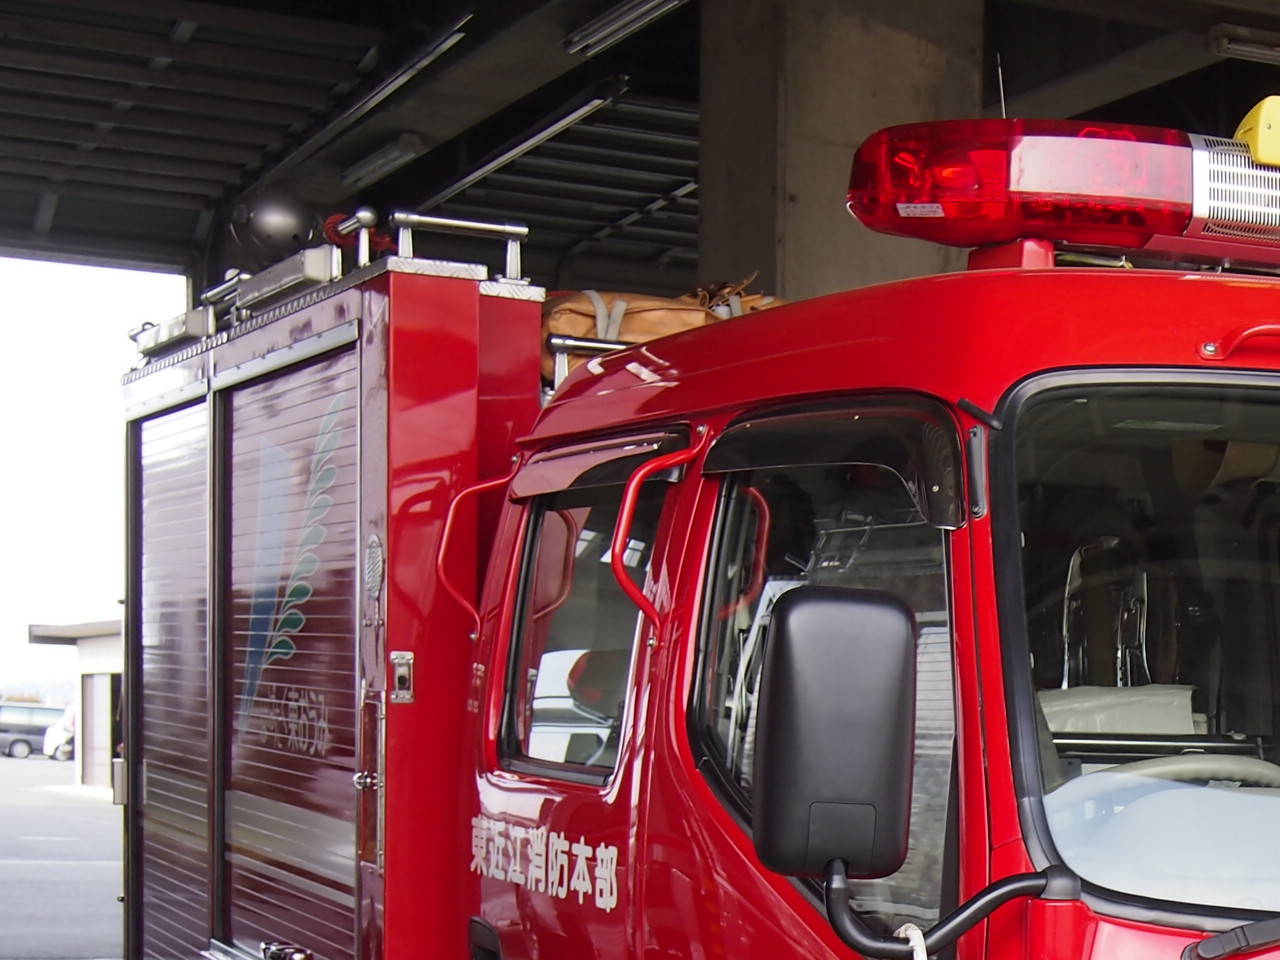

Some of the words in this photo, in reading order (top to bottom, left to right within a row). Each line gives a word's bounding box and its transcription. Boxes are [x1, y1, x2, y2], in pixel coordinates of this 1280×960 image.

[470, 813, 619, 914] 東近江消防本部
